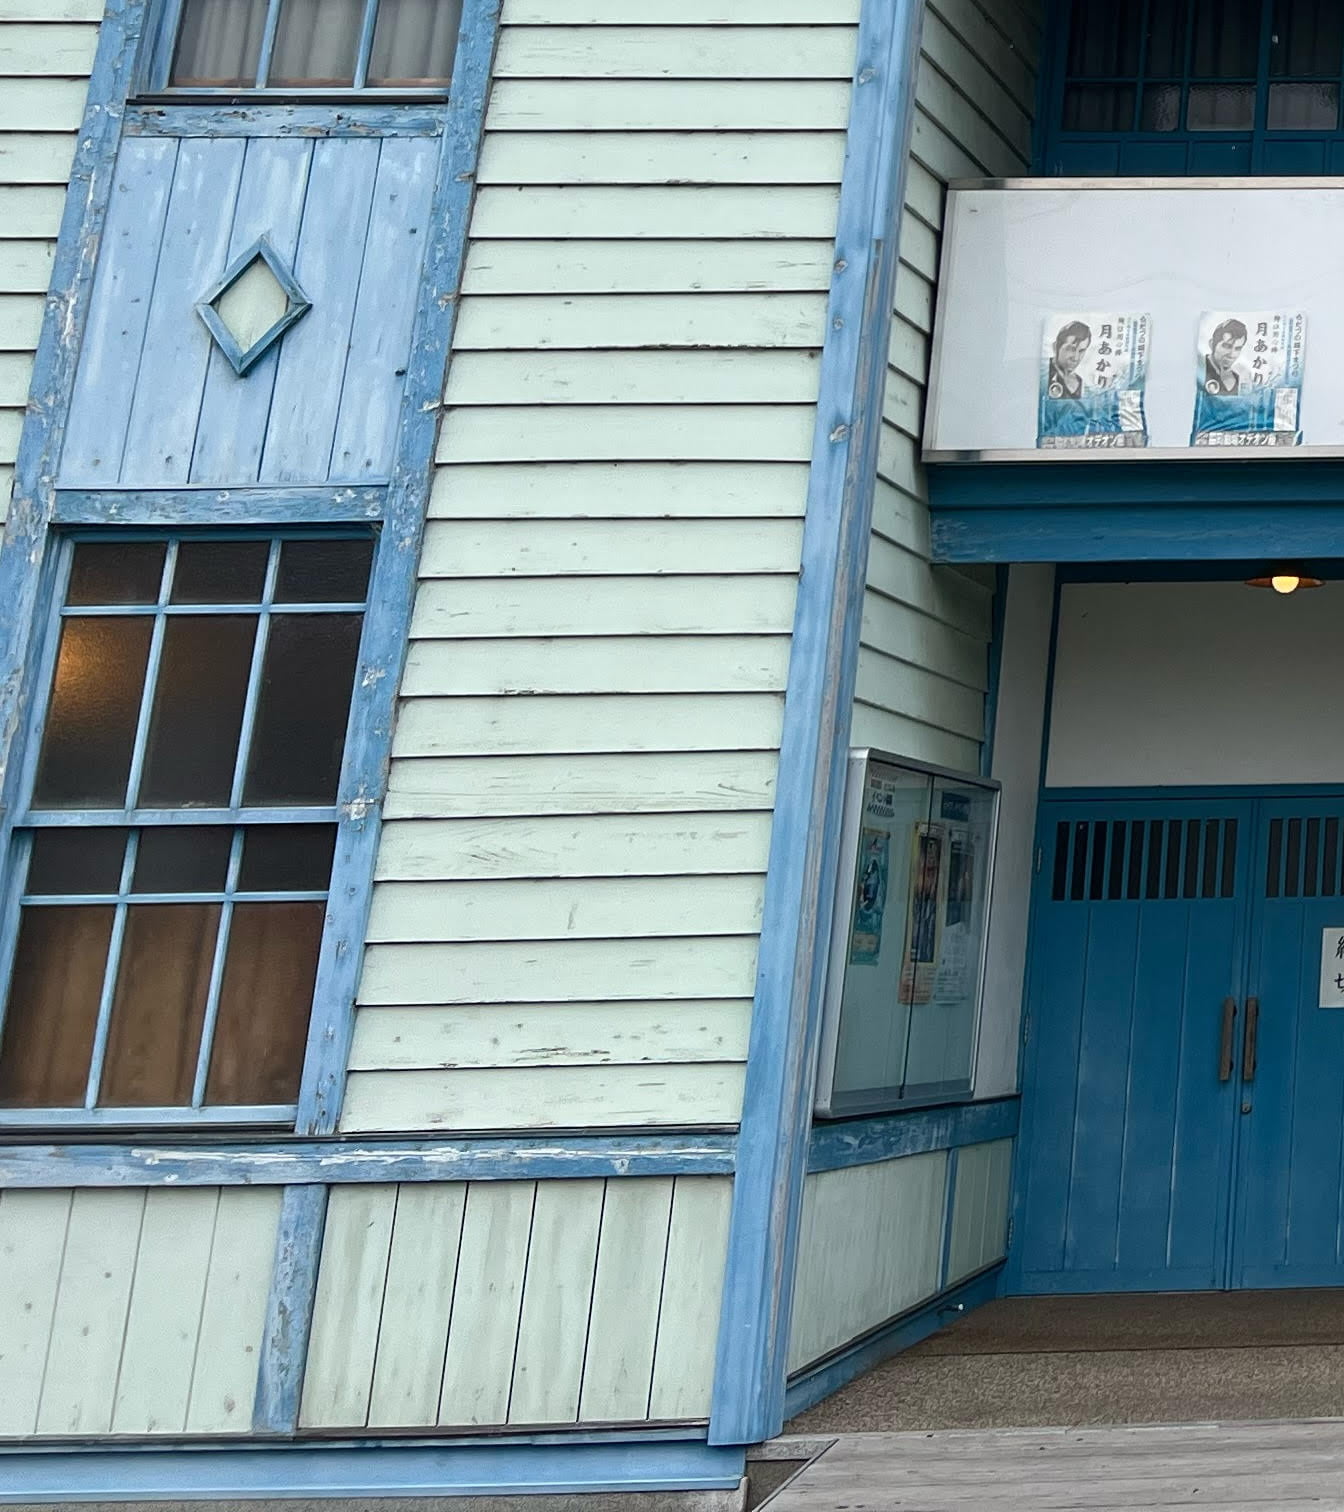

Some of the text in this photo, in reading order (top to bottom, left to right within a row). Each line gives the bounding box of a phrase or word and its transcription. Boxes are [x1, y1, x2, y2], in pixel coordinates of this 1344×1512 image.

[1096, 324, 1112, 387] 月あかり
[1252, 322, 1268, 385] 月あかり
